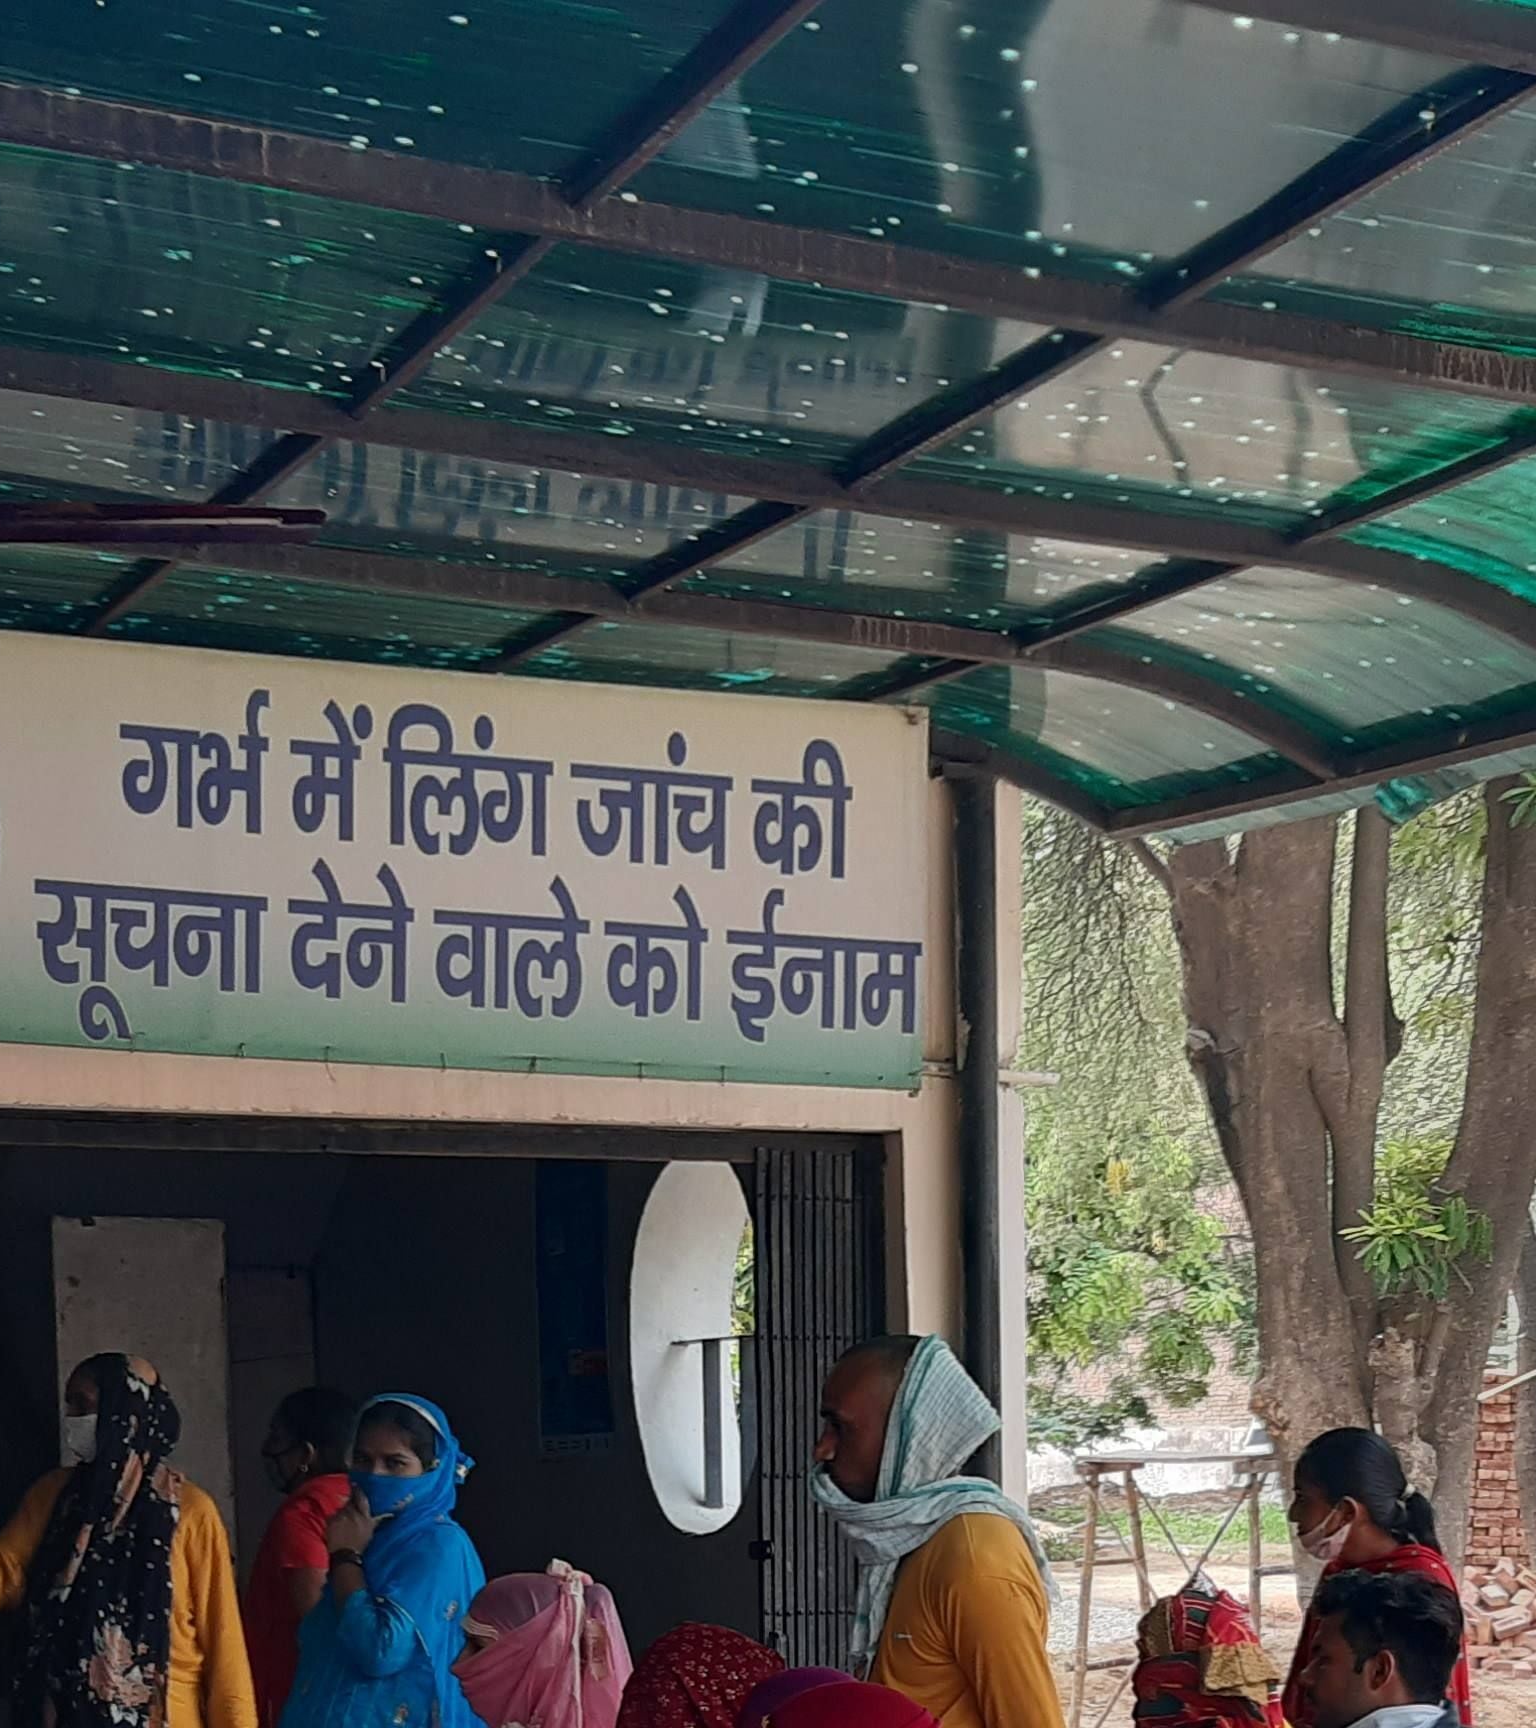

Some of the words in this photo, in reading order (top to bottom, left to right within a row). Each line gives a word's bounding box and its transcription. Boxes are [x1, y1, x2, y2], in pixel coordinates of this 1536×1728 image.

[119, 689, 269, 836] गर्भ
[290, 699, 372, 843] में
[384, 705, 552, 860] लिंग
[572, 733, 731, 871] जांच
[753, 740, 852, 880] की
[34, 878, 268, 1041] सूचना
[287, 859, 414, 1001] देने
[434, 876, 591, 1018] वाले
[605, 884, 705, 1023] को
[728, 887, 922, 1045] ईनाम
